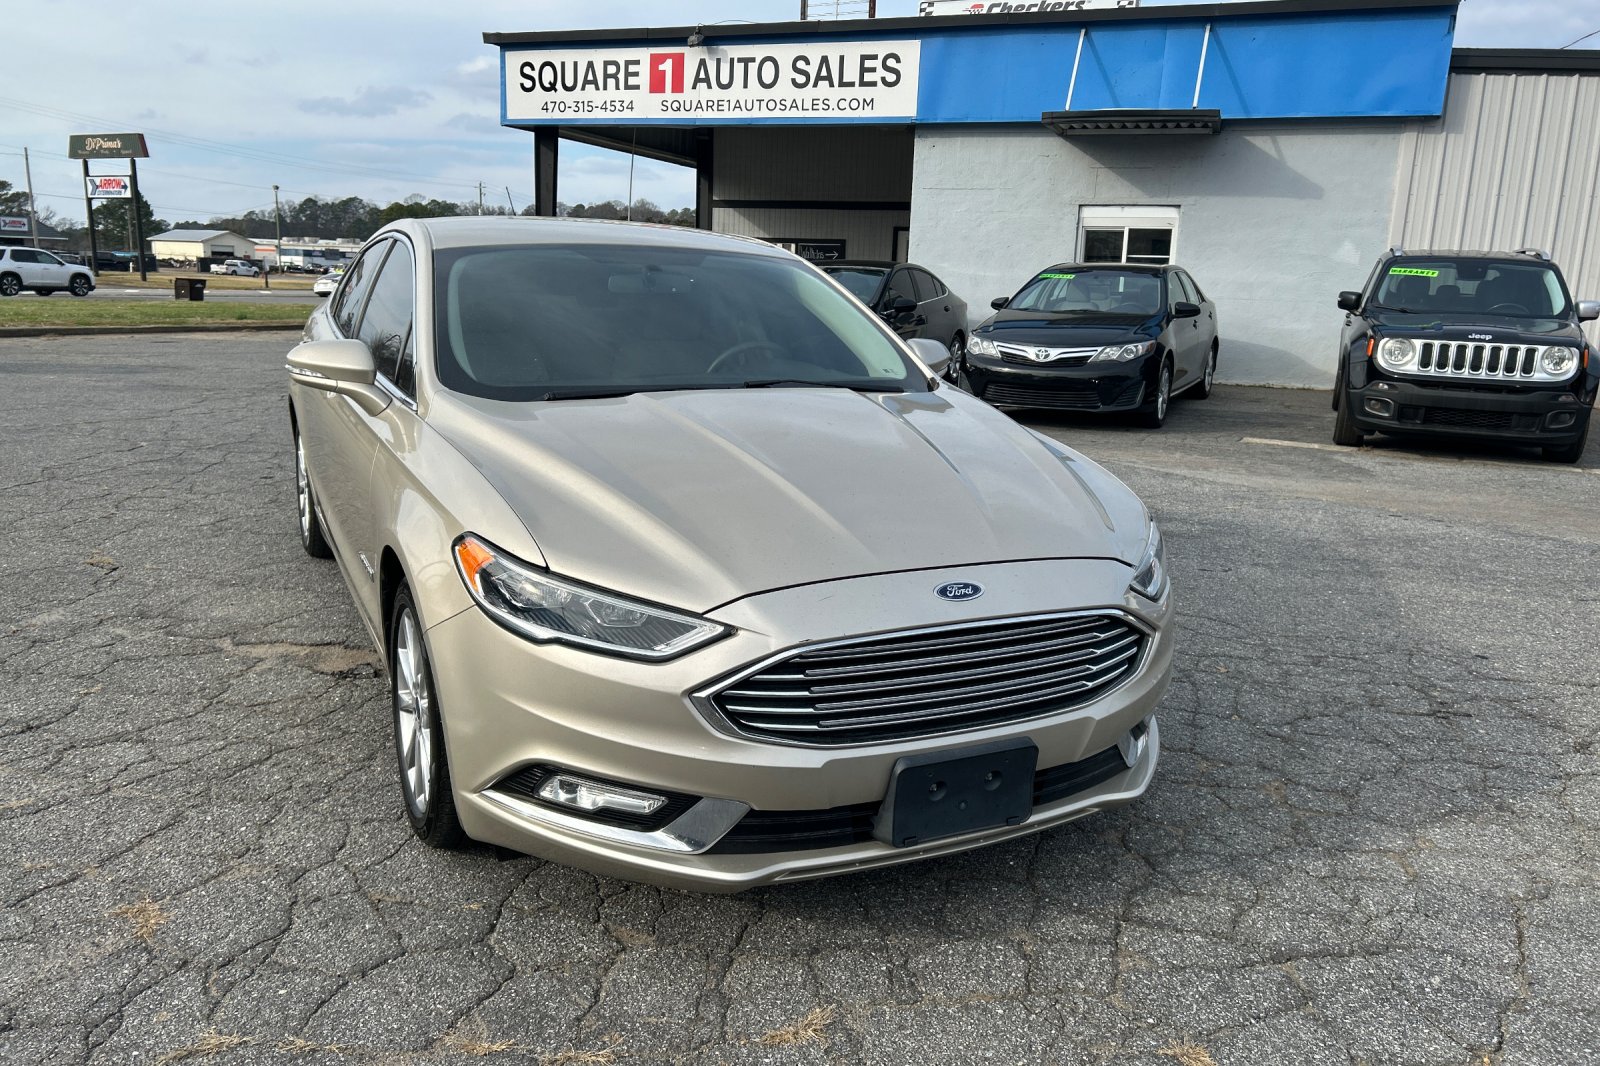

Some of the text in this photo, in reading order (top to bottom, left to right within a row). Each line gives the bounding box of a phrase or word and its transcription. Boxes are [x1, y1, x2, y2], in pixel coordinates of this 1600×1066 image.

[519, 59, 641, 93] SQUARE
[691, 55, 780, 90] AUTO
[790, 52, 902, 89] SALES
[541, 97, 875, 113] 470-315-4534 SQUARE1AUTOSALES.COM
[98, 178, 122, 190] ARROW
[1468, 333, 1493, 341] Jeep
[946, 584, 974, 597] Ford
